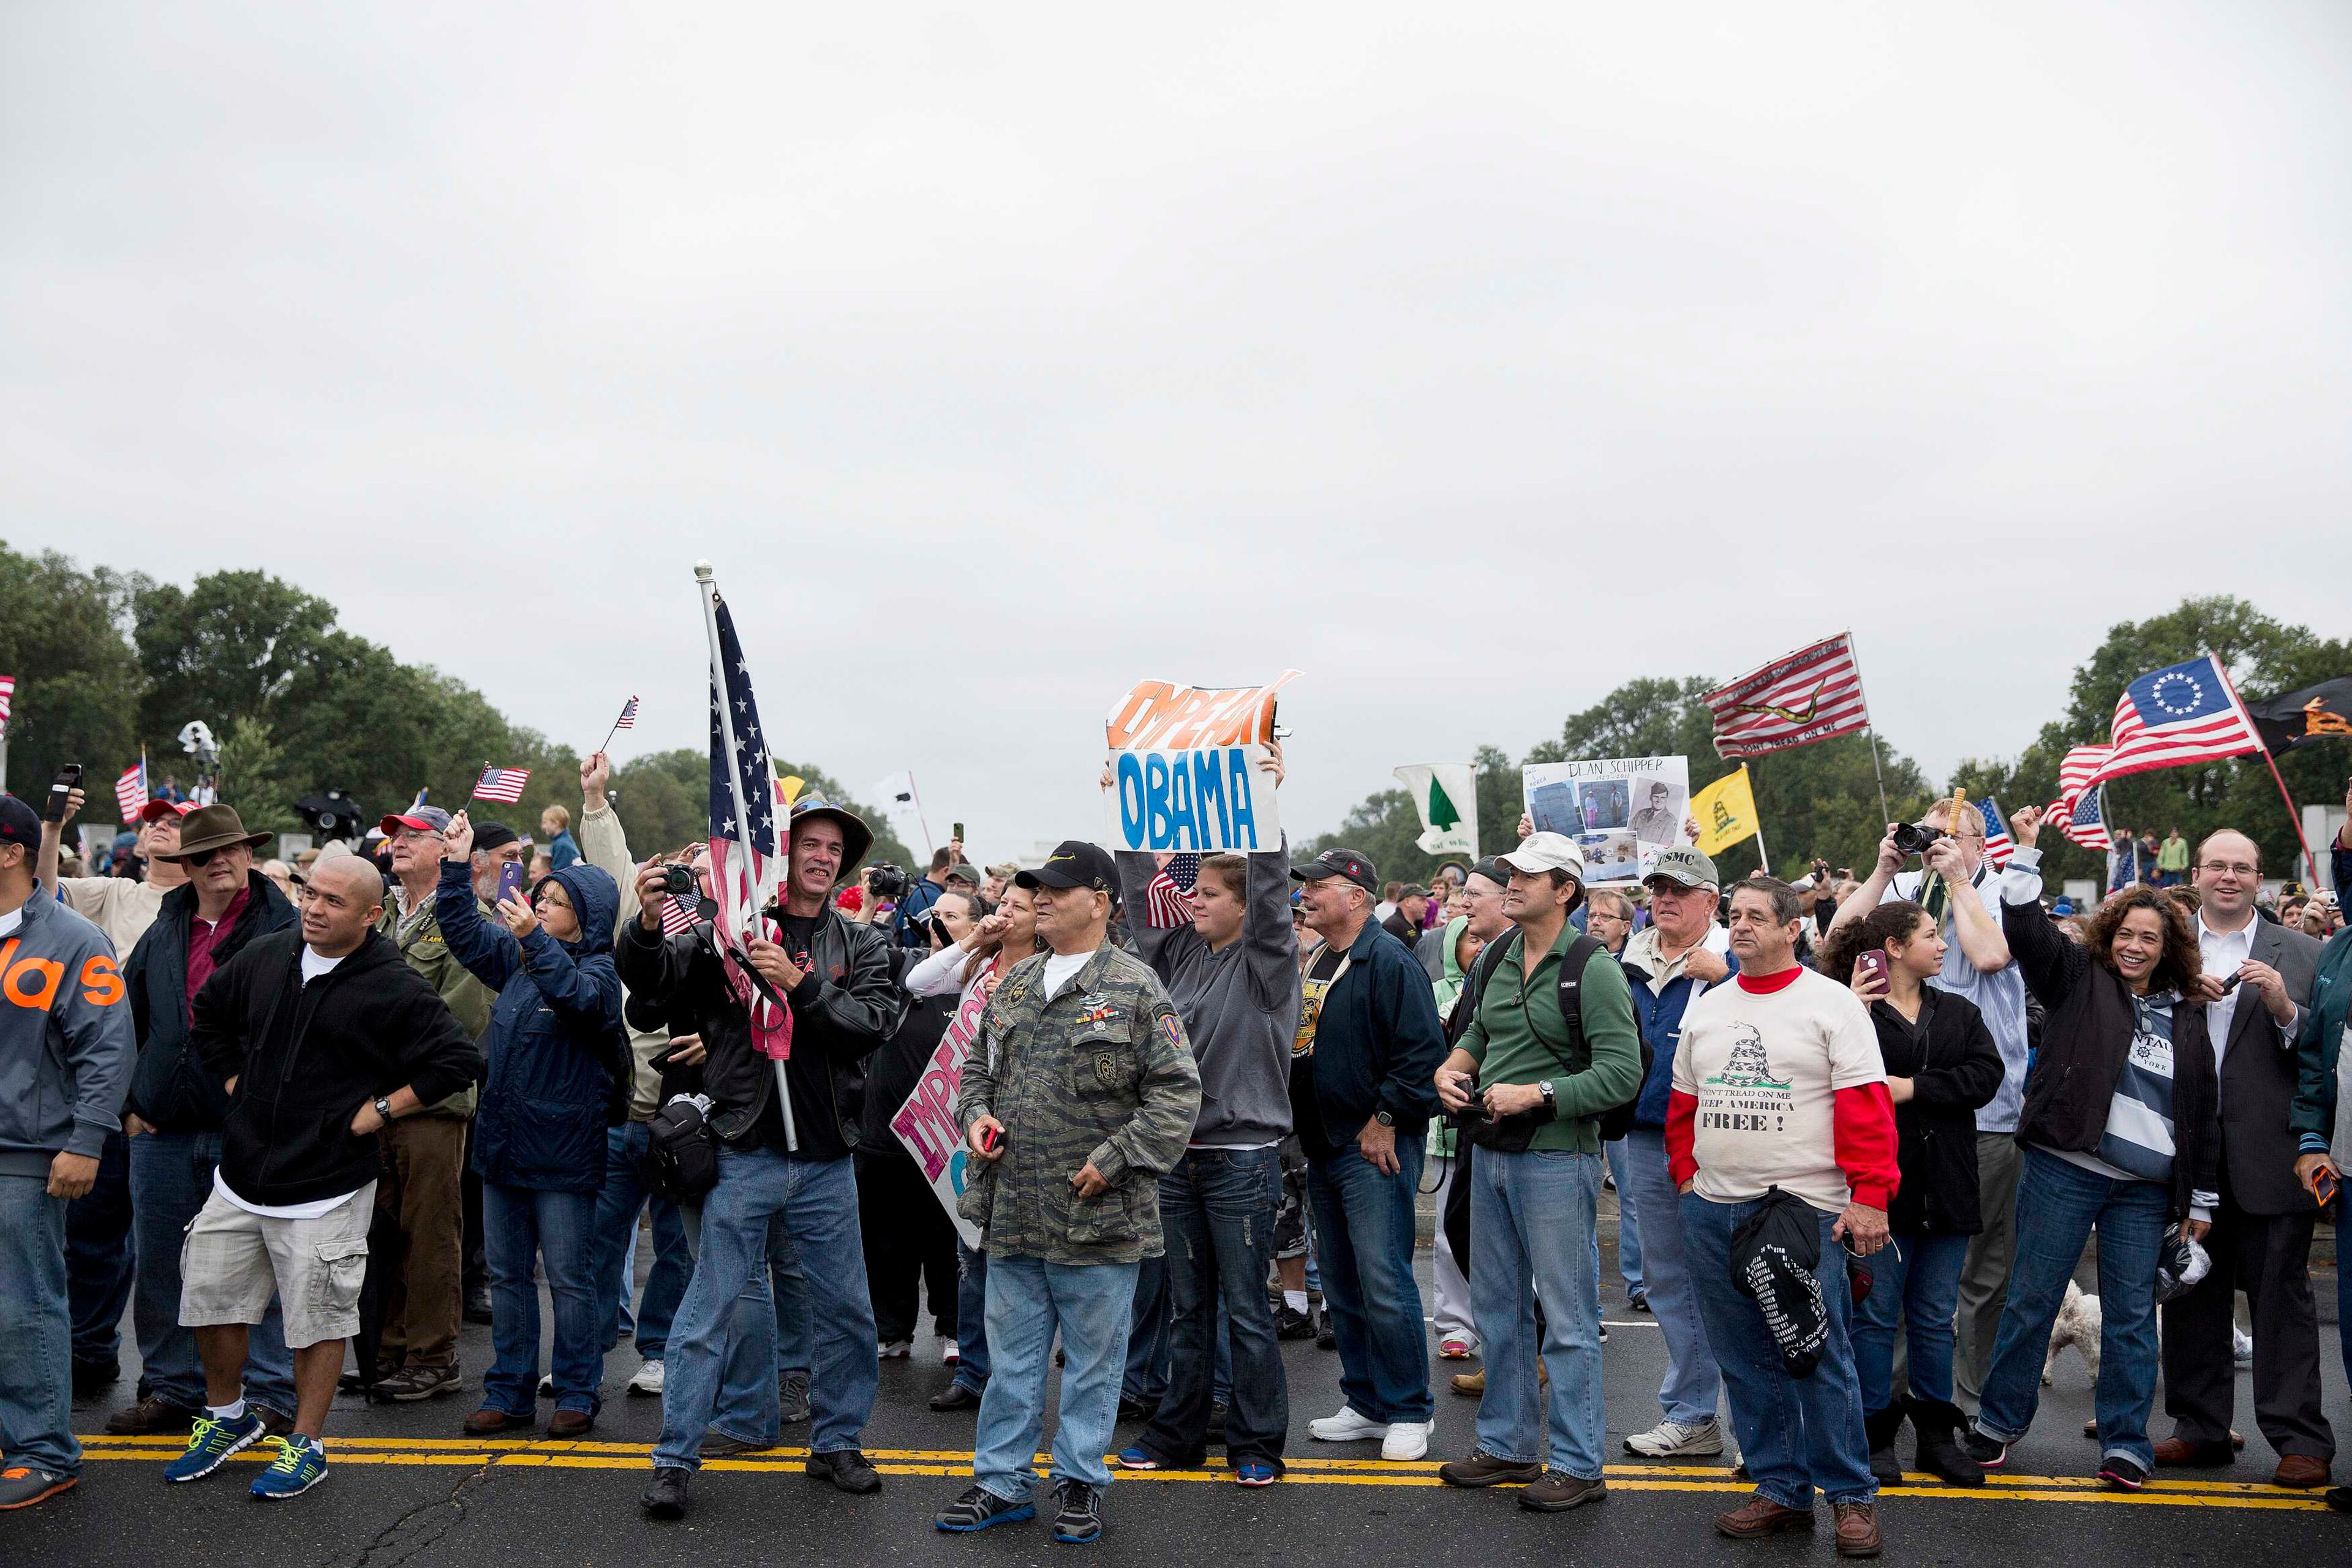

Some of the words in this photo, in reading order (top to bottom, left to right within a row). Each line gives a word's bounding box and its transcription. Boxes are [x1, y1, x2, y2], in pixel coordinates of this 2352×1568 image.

[1771, 736, 1799, 748] TREAD
[1804, 729, 1818, 739] ON
[1823, 722, 1838, 734] ME
[1569, 762, 1603, 777] DEAN
[1610, 758, 1667, 774] SCHIPPER
[1118, 748, 1257, 851] OBAMA
[1657, 851, 1695, 867] USMC
[419, 912, 434, 931] SONY
[2144, 1059, 2166, 1071] YORK
[1700, 1099, 1724, 1108] KEEP
[1727, 1100, 1795, 1111] AMERICA
[1703, 1112, 1767, 1131] FREE
